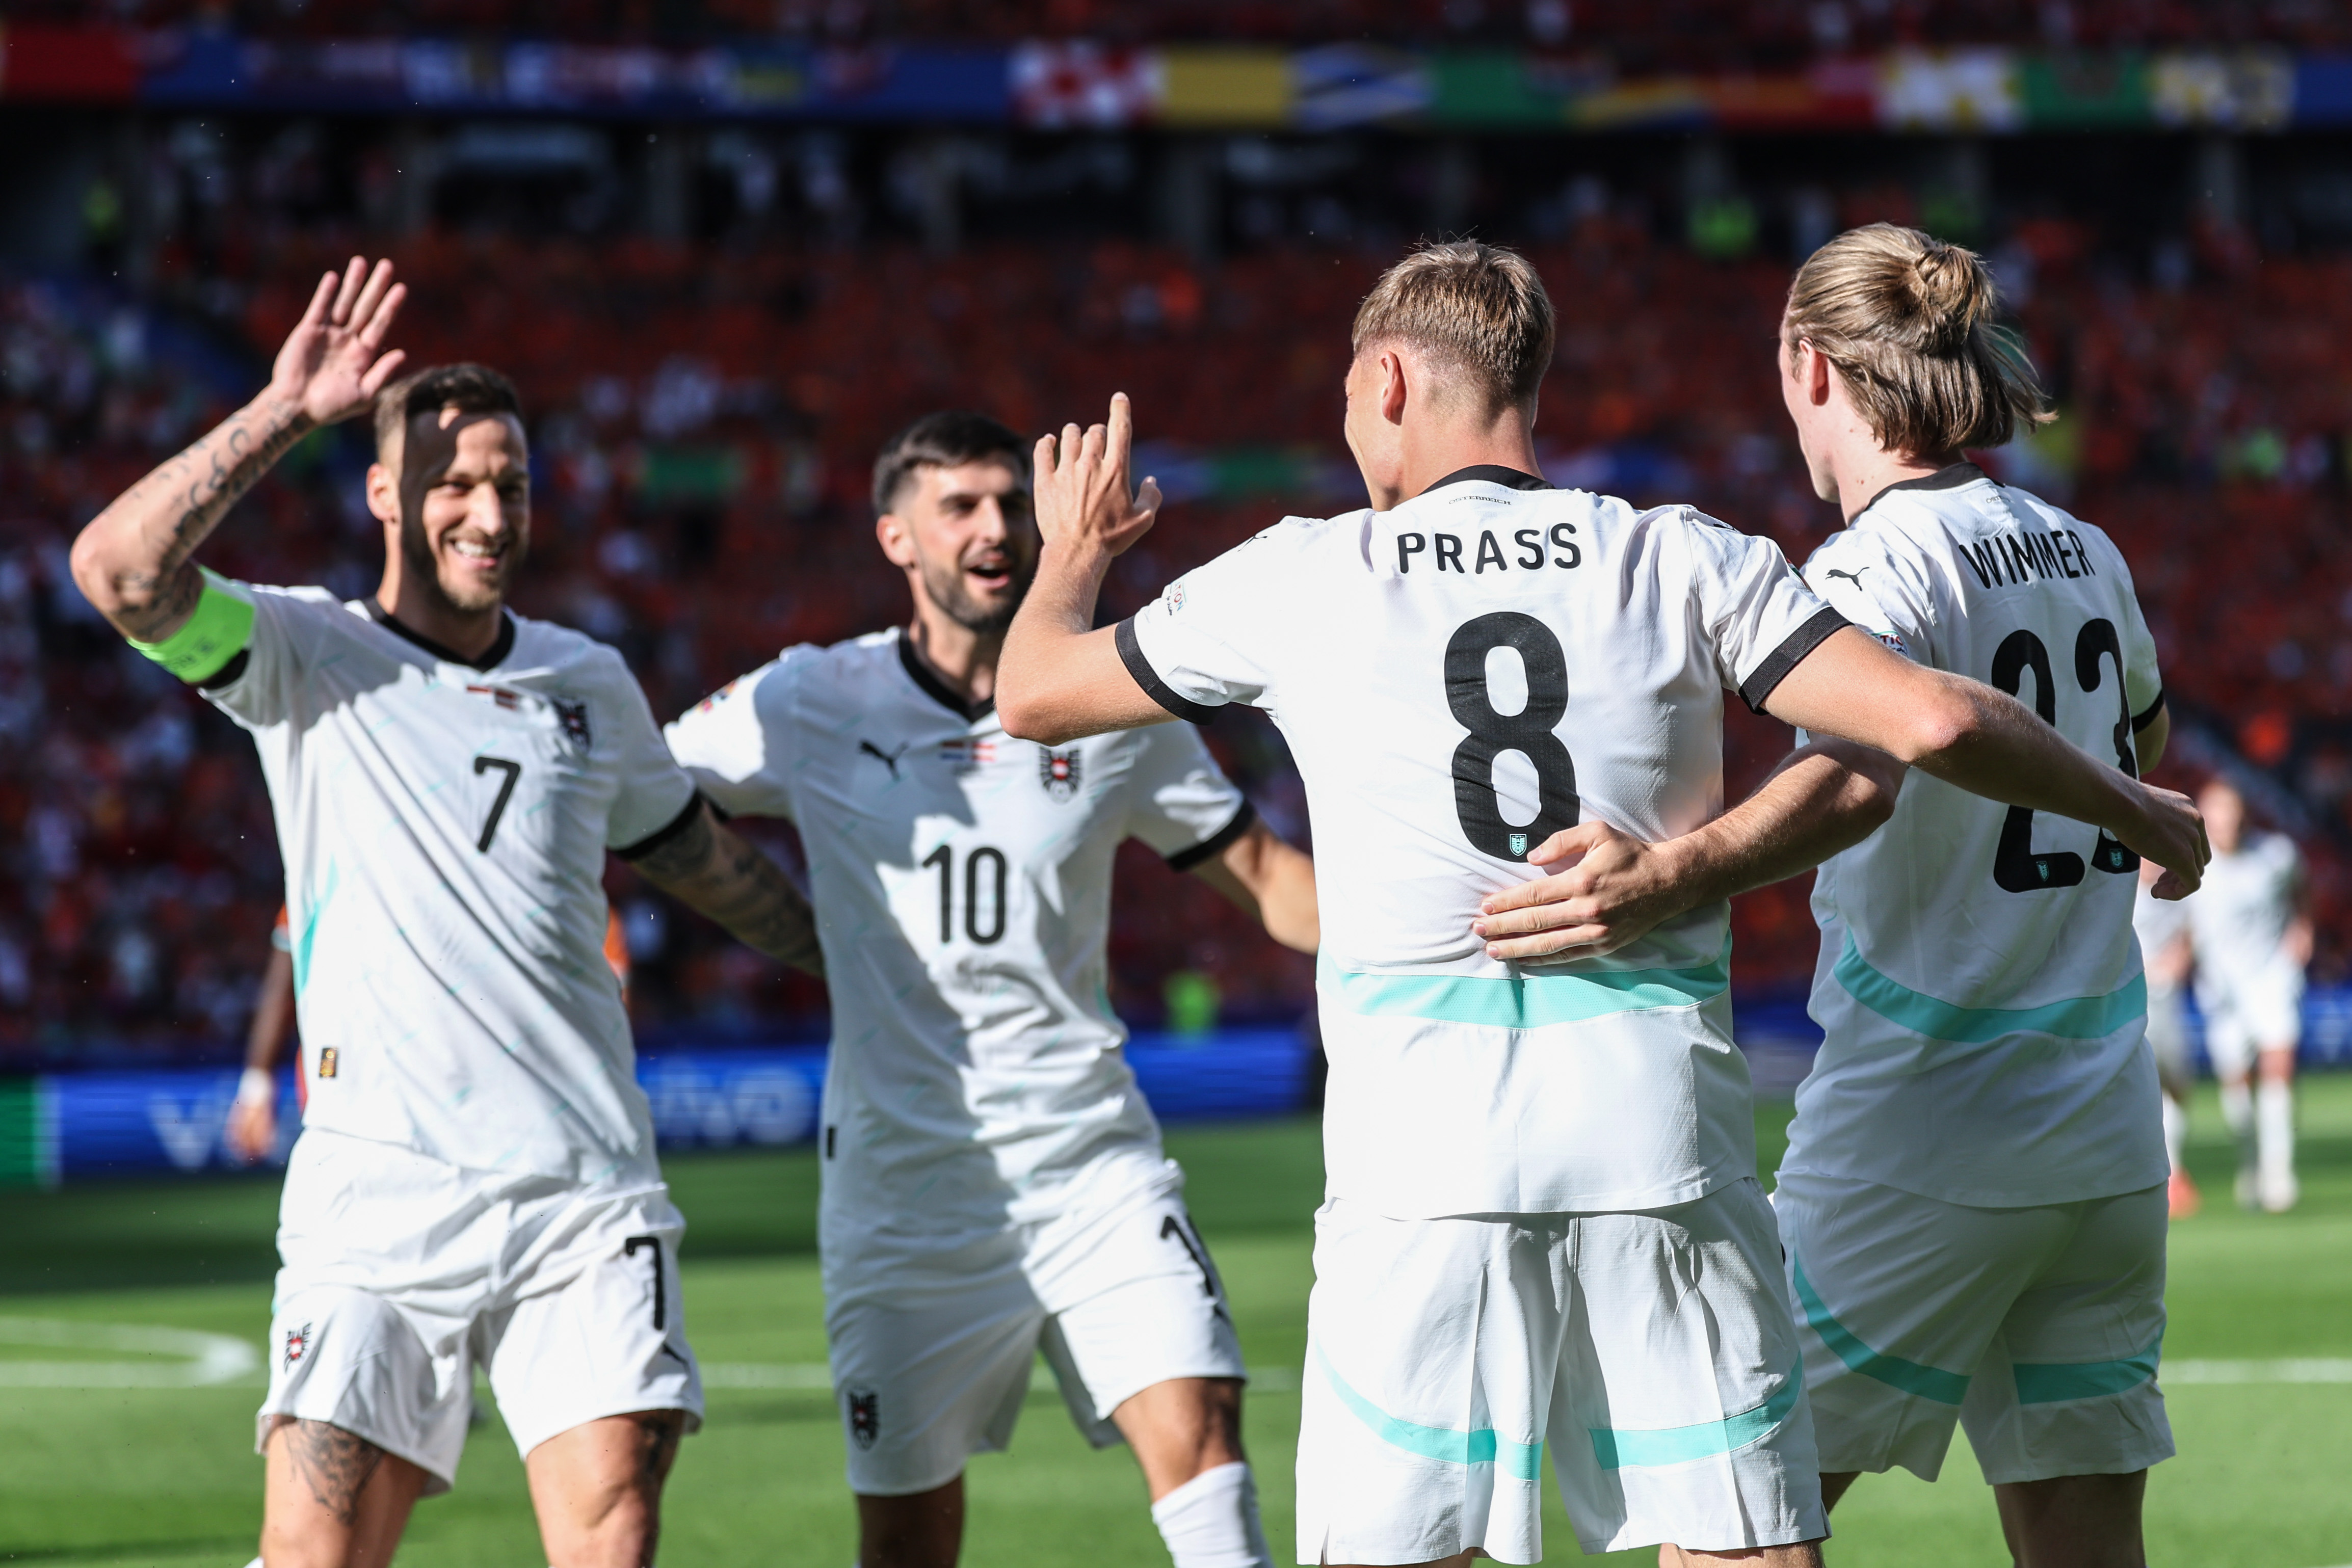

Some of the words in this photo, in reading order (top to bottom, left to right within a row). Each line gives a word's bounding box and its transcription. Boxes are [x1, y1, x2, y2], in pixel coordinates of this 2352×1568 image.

[1397, 523, 1581, 574] PRASS
[1959, 529, 2096, 589] WIMMER
[1444, 611, 1581, 863] 8
[474, 756, 521, 853] 7
[922, 844, 1007, 945] 10
[625, 1236, 665, 1330] 7
